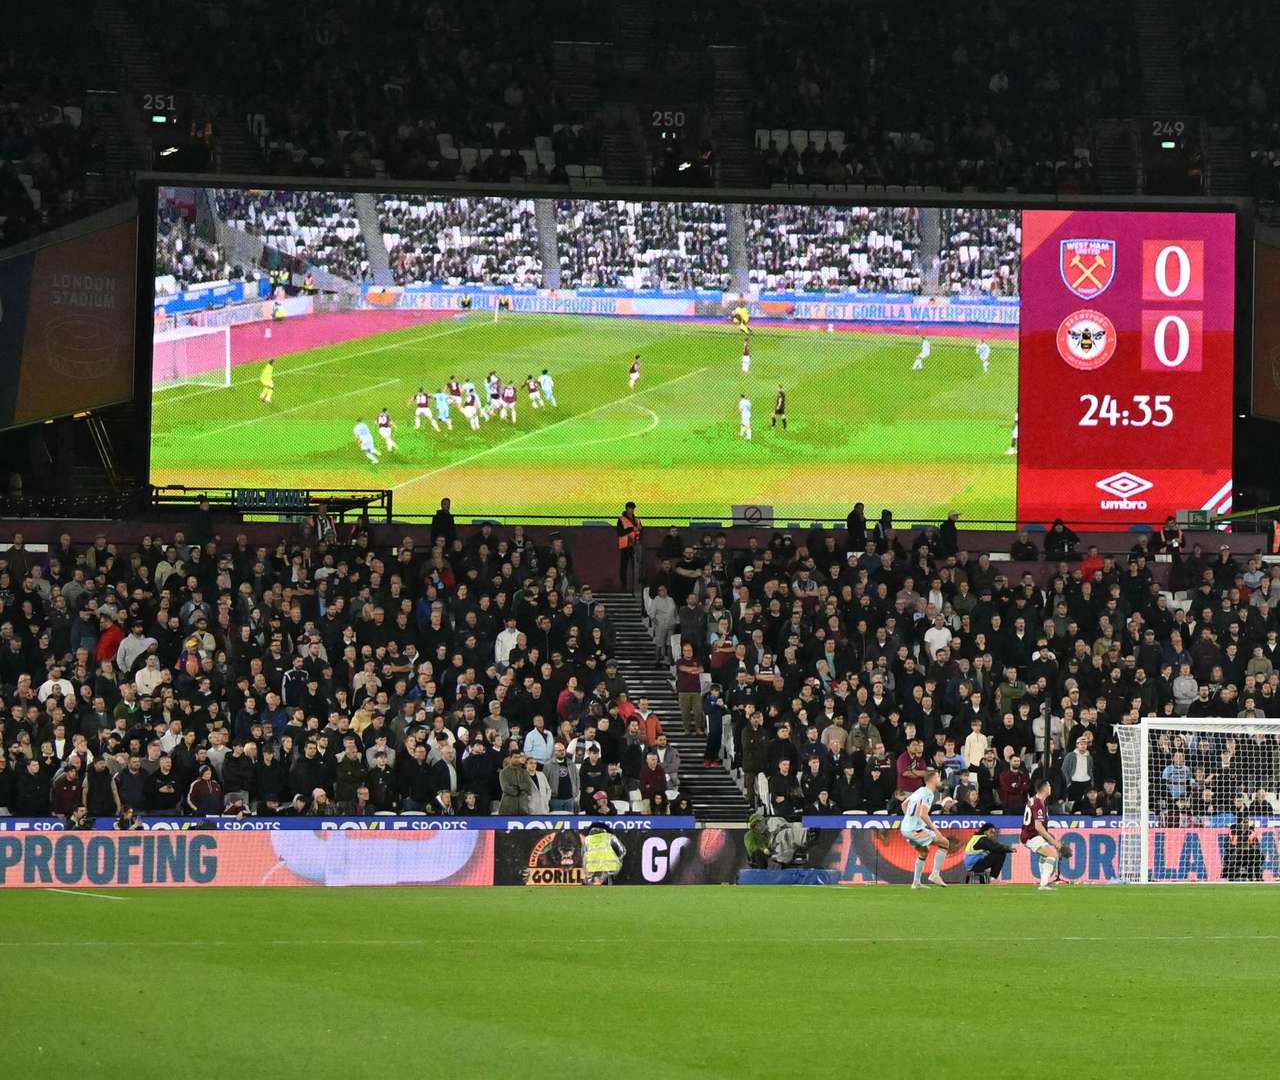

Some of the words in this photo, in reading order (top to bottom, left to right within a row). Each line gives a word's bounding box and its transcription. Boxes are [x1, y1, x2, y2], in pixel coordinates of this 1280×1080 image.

[143, 93, 176, 111] 251
[651, 111, 686, 128] 250
[1151, 120, 1185, 137] 249
[1066, 242, 1089, 251] WEST
[1090, 242, 1110, 251] HAM
[1155, 245, 1191, 298] 0
[52, 274, 116, 291] LONDON
[51, 290, 116, 308] STADIUM
[825, 304, 847, 320] GET
[851, 304, 907, 321] GORILLA
[1154, 315, 1190, 368] 0
[1078, 394, 1174, 427] 24:35
[1100, 497, 1148, 511] umbro
[411, 822, 469, 830] SPORTS
[0, 834, 218, 885] PROOFING
[531, 869, 583, 884] GORILL
